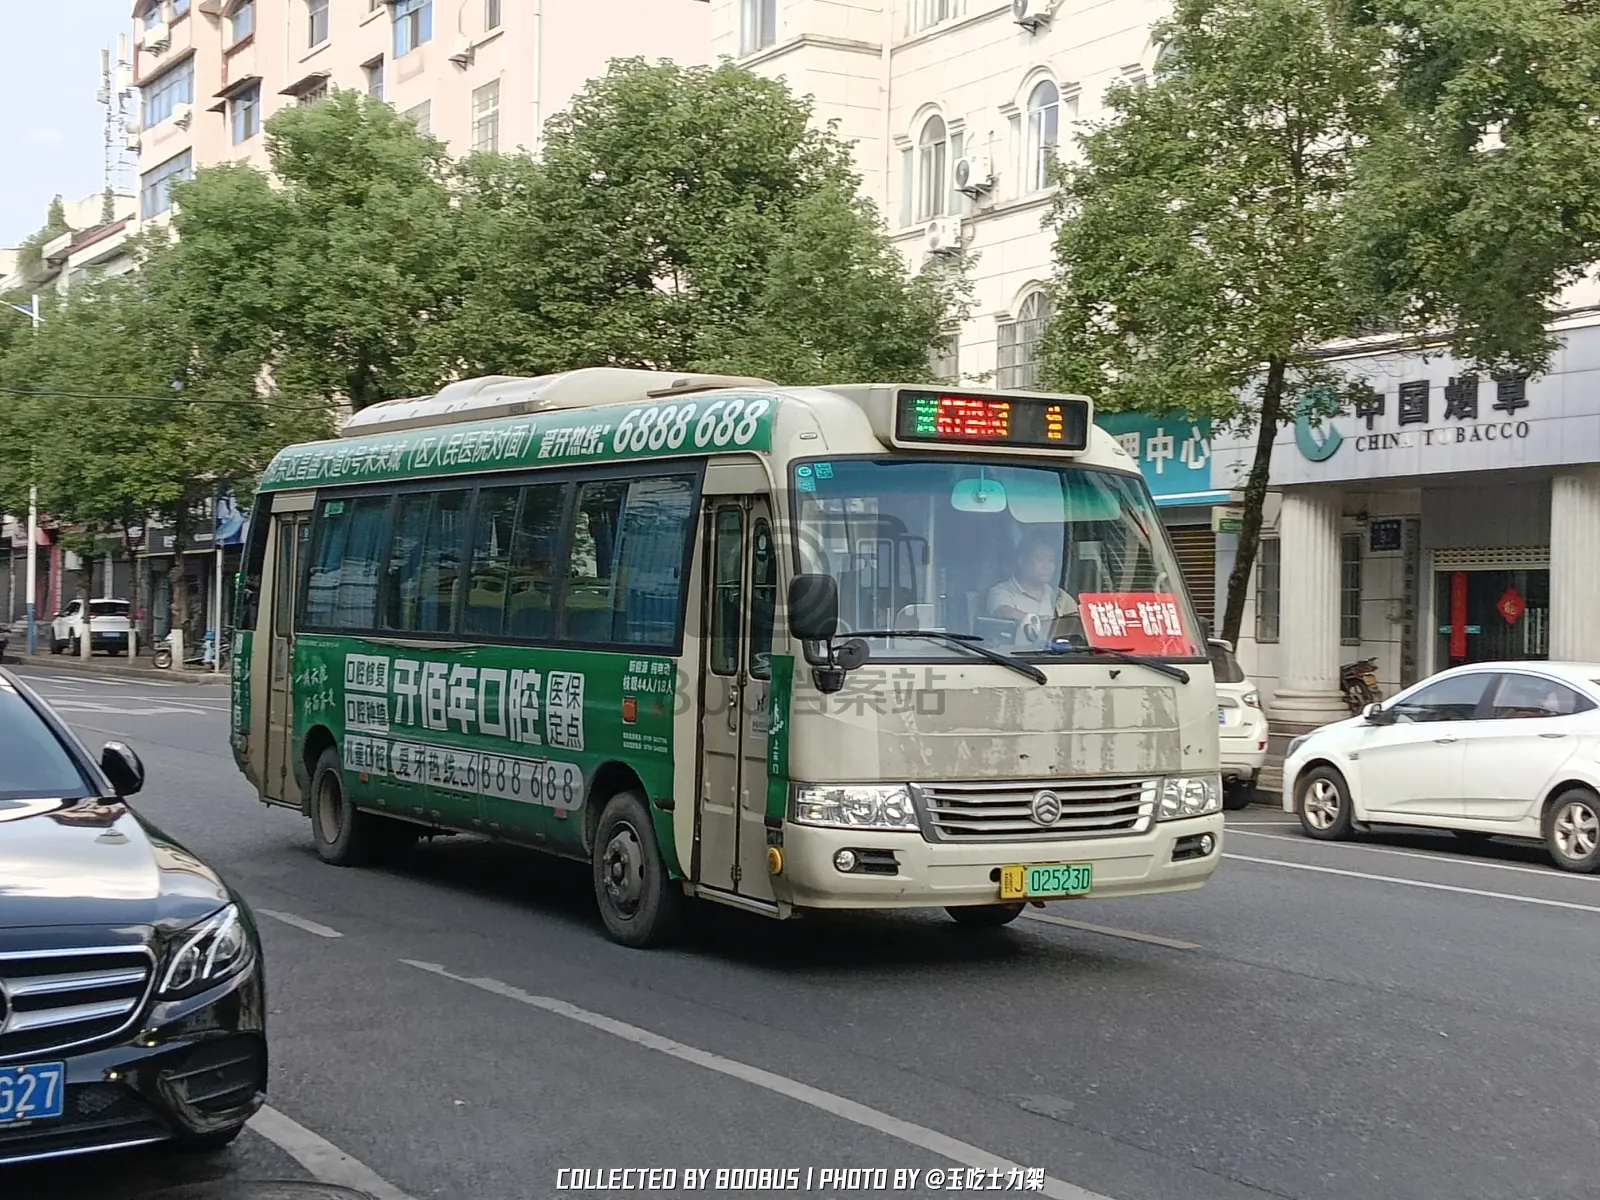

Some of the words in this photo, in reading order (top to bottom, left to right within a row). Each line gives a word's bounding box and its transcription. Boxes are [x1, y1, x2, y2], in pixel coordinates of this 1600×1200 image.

[1356, 372, 1530, 430] 中国烟草
[613, 402, 696, 453] 6888
[694, 399, 770, 449] 688
[1356, 433, 1414, 453] CHIN
[1422, 421, 1529, 446] TBACCO
[548, 674, 581, 710] 医保
[548, 711, 582, 749] 定点
[467, 755, 521, 795] 6888
[530, 764, 573, 804] 688
[0, 1071, 59, 1113] G27
